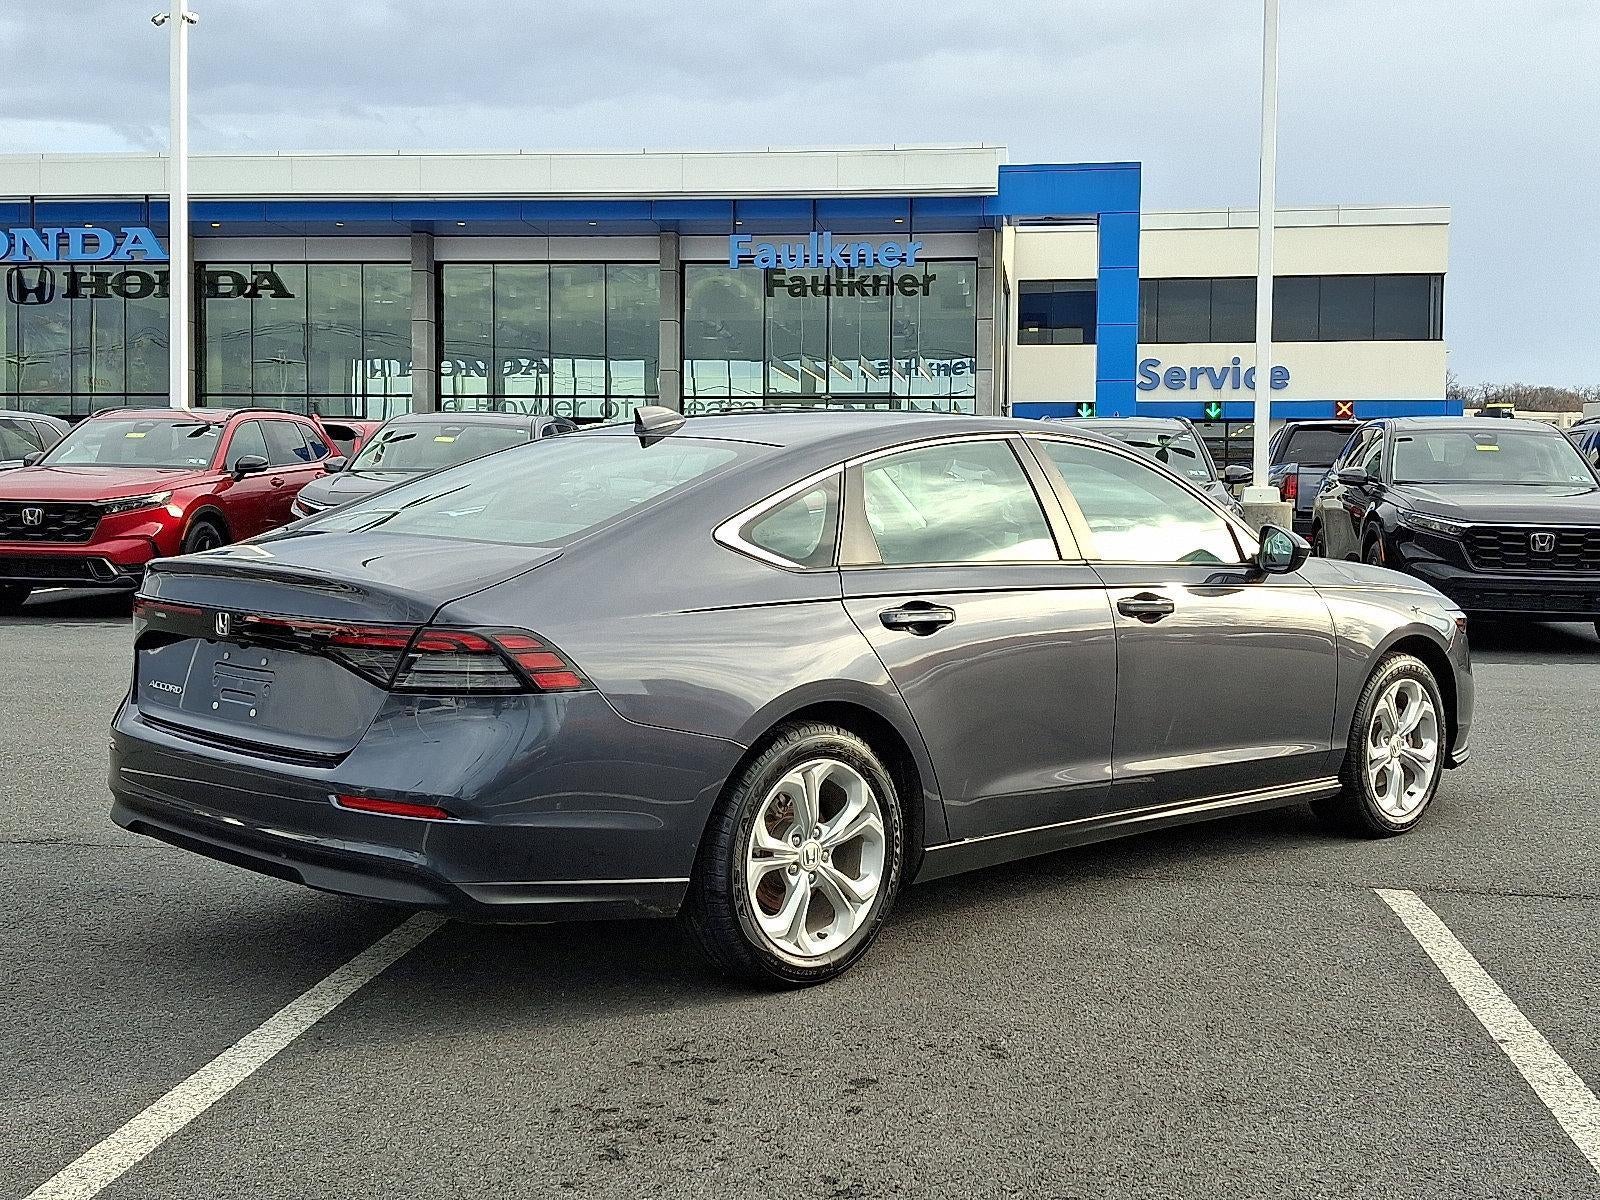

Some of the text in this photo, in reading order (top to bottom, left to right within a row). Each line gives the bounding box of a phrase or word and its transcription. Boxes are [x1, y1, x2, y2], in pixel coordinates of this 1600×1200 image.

[0, 227, 169, 261] NDA
[729, 231, 922, 269] Faulkner
[766, 266, 936, 297] Faulkner
[149, 680, 182, 694] ACCORD
